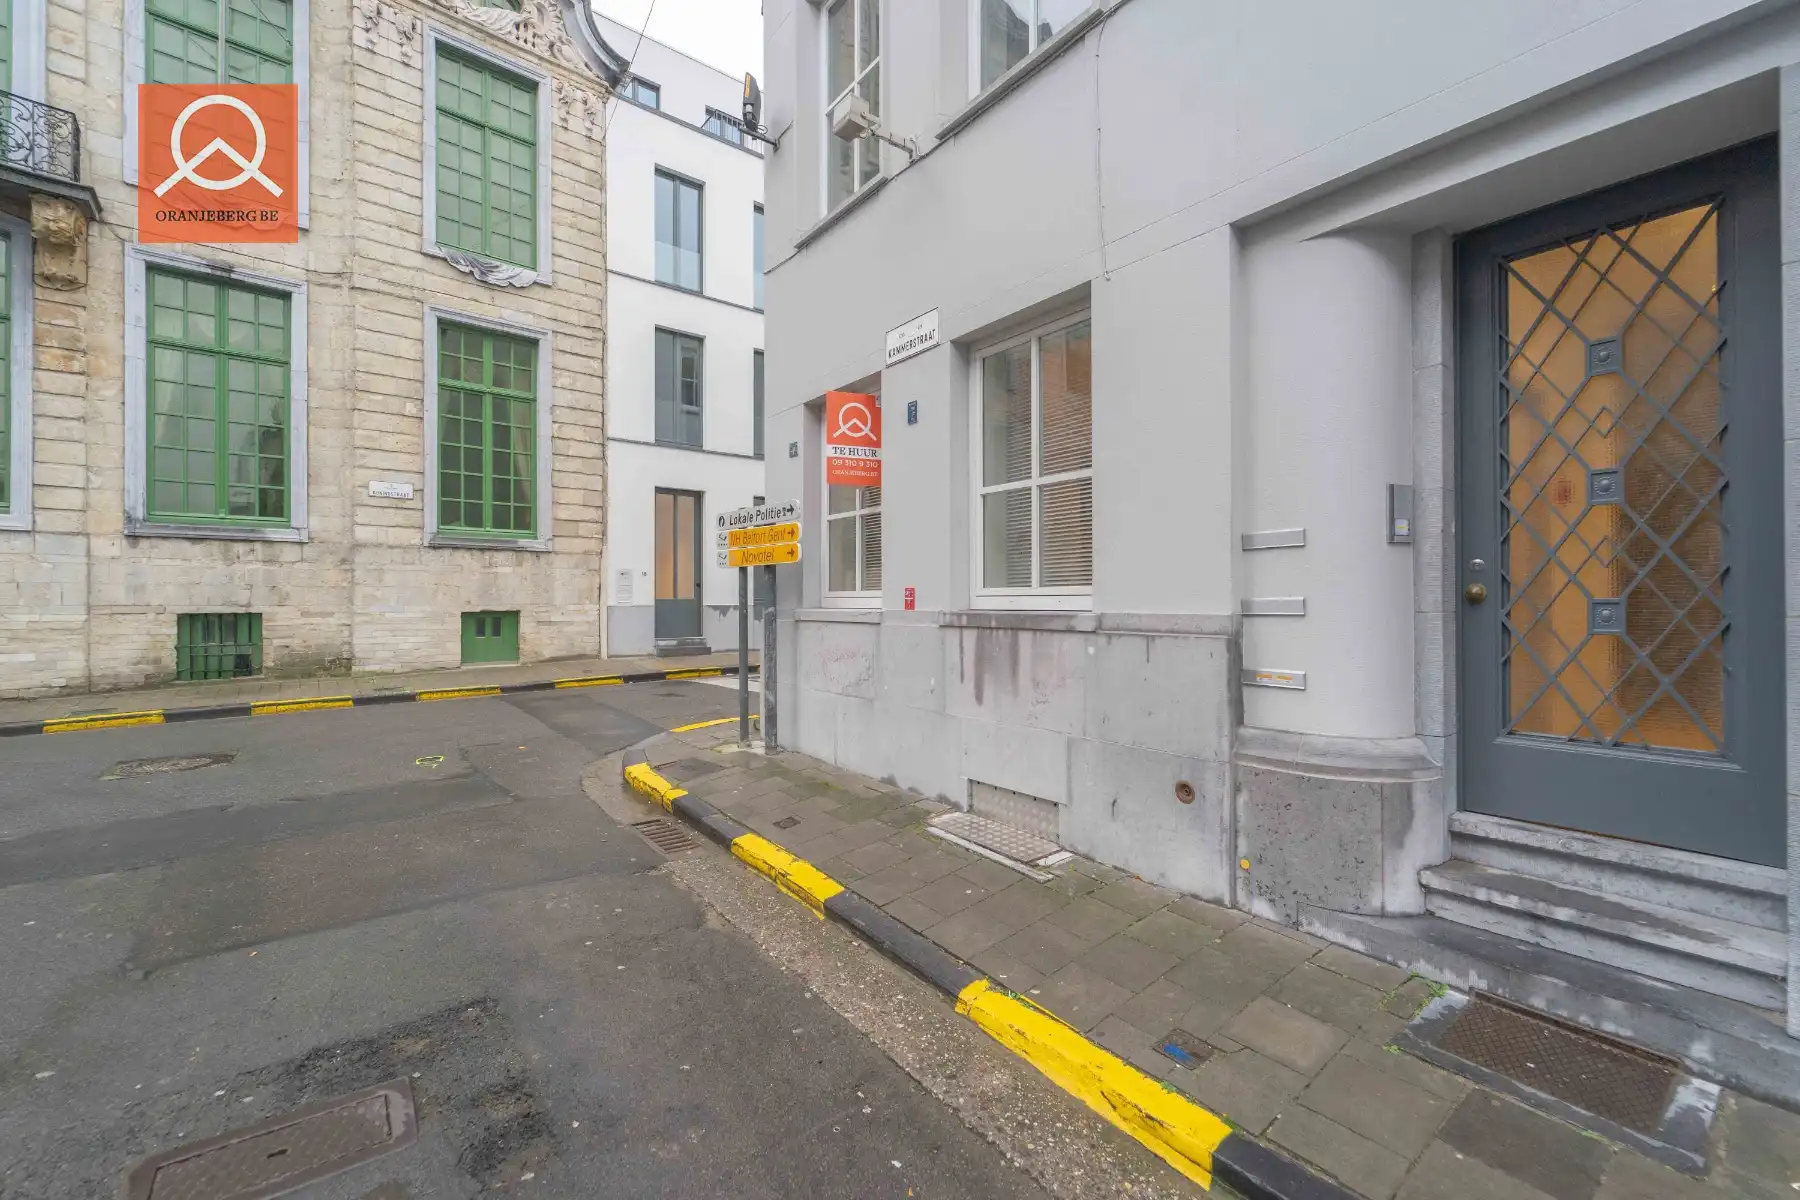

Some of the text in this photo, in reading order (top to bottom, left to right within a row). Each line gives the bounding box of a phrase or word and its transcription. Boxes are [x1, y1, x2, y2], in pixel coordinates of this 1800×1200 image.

[888, 328, 936, 359] KAMMERSTRAAT
[832, 446, 878, 458] TE HUUR
[729, 507, 782, 526] Lokale Politie
[741, 549, 774, 564] Novotel
